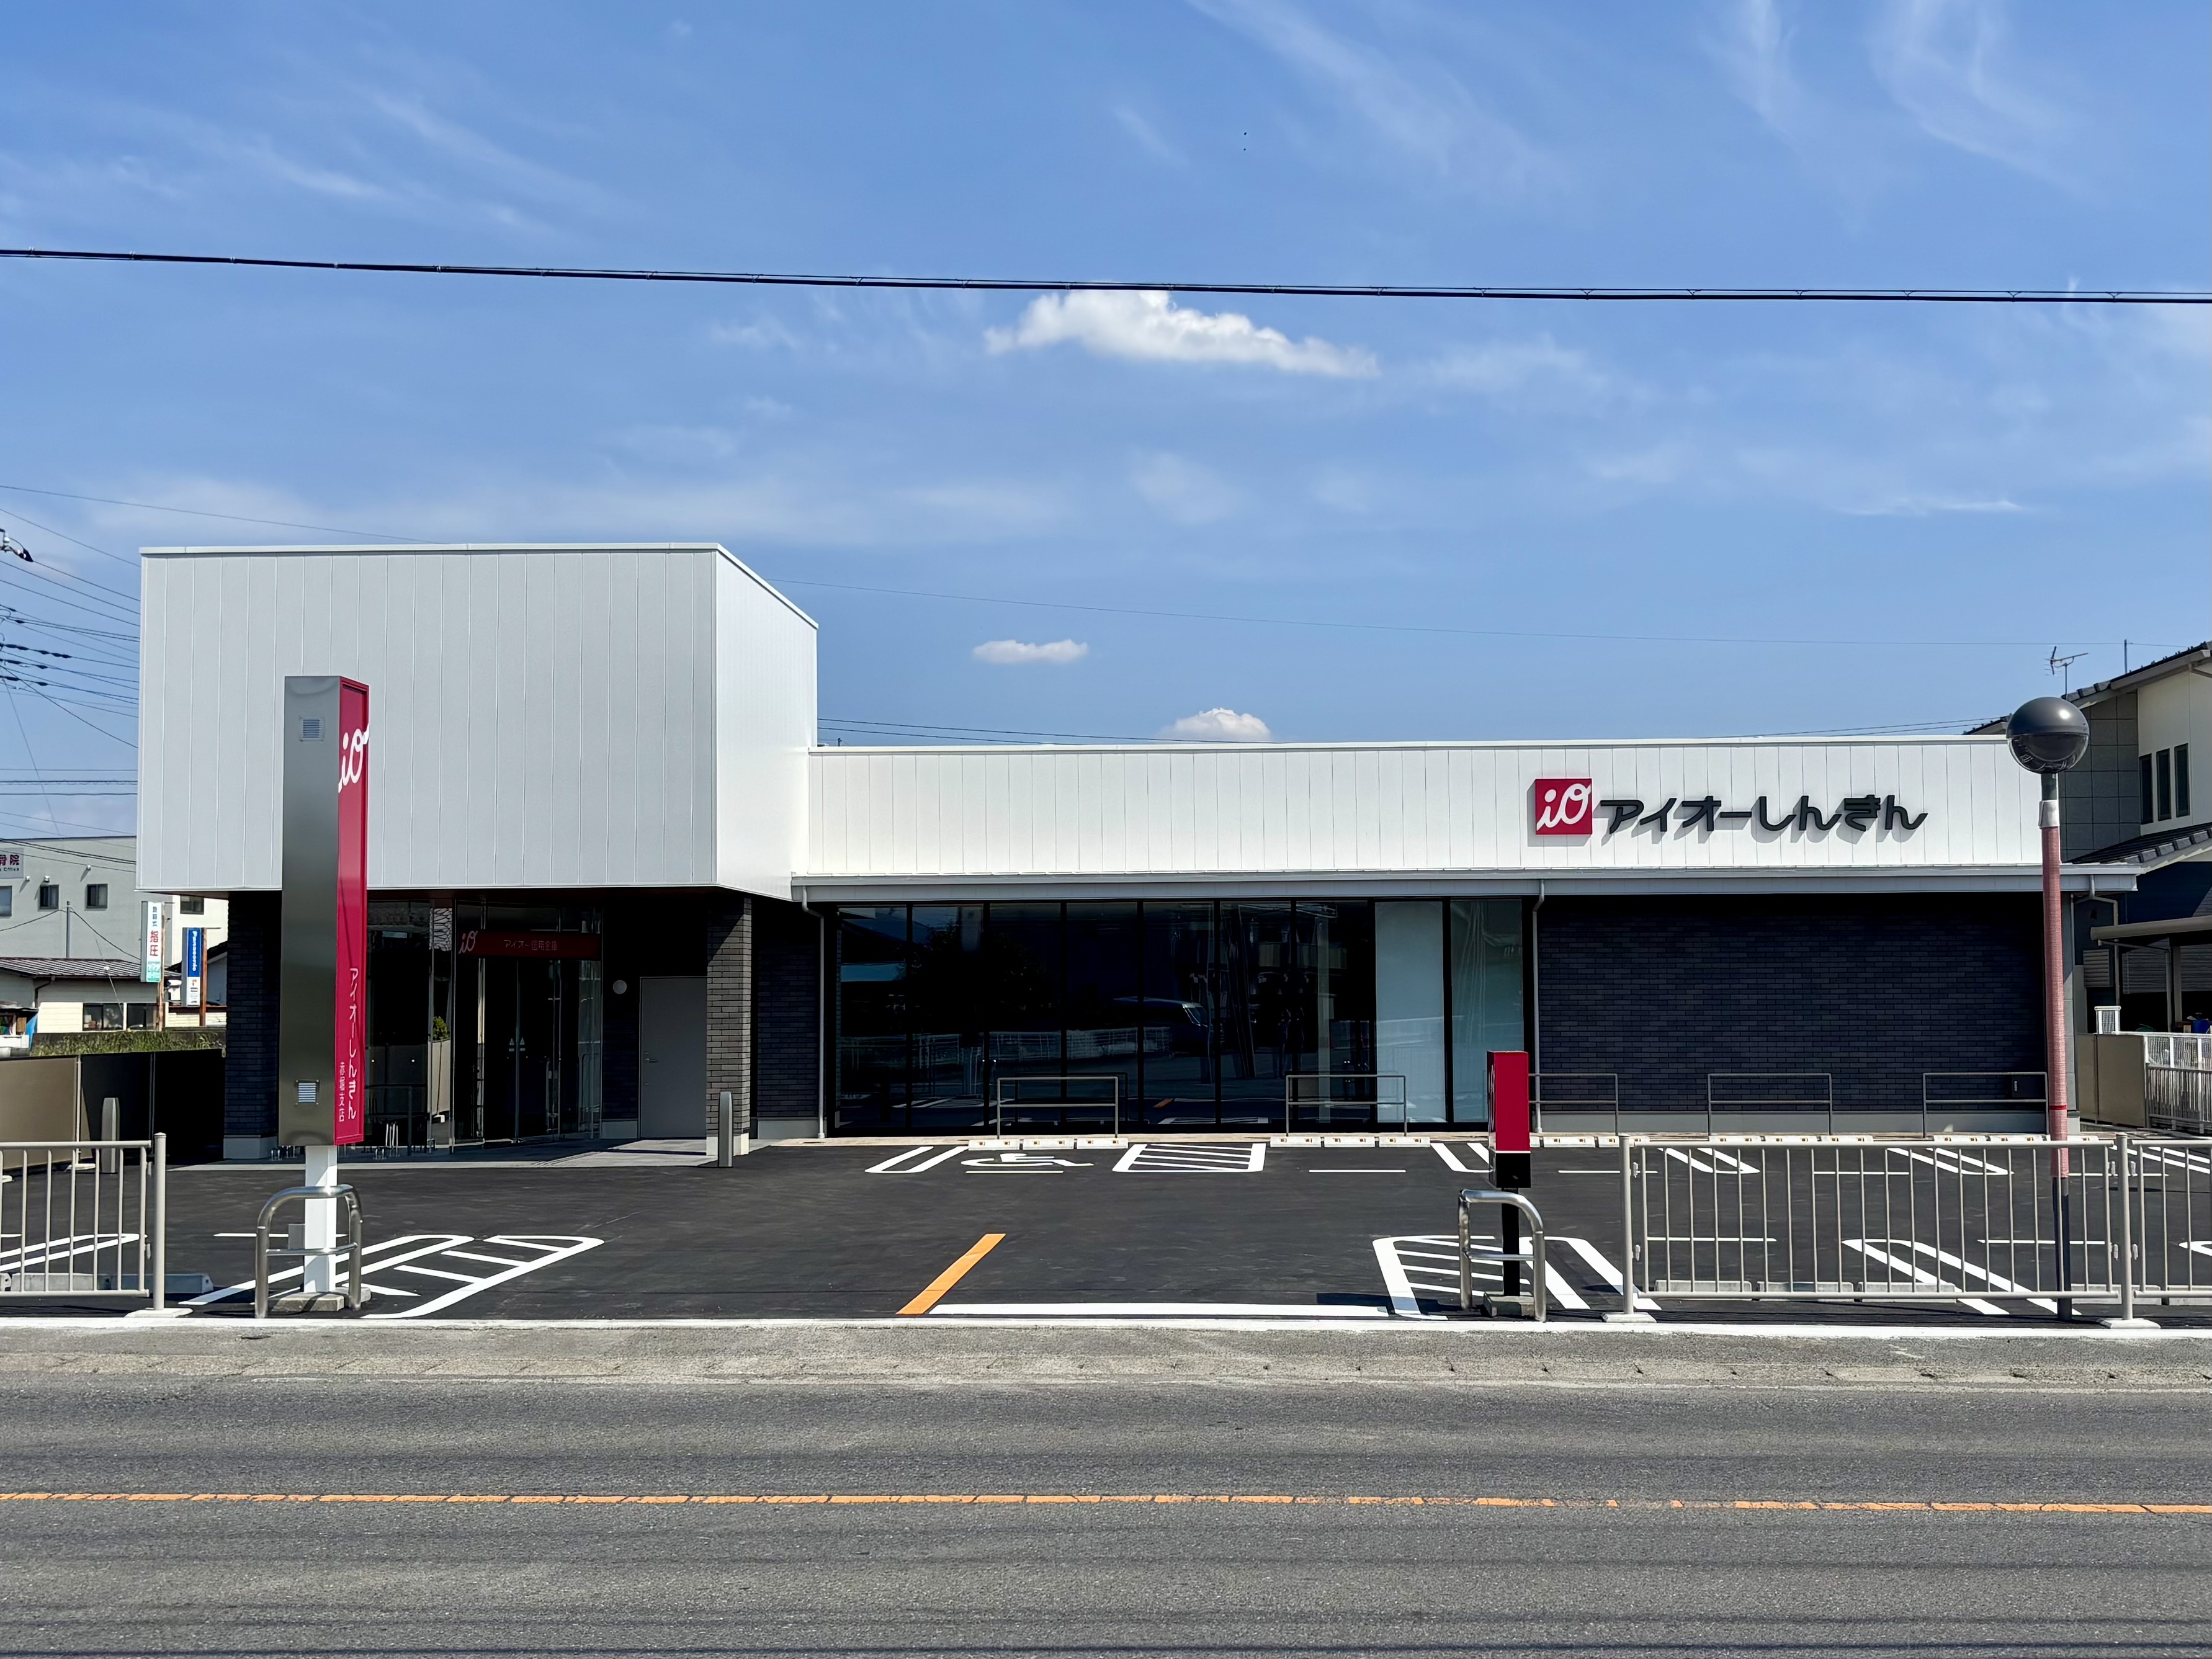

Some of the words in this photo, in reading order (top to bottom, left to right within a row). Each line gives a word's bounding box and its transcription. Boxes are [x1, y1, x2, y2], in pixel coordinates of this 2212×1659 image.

[1599, 794, 1928, 833] アイオーしんきん
[348, 968, 359, 1120] アイオーしんきん
